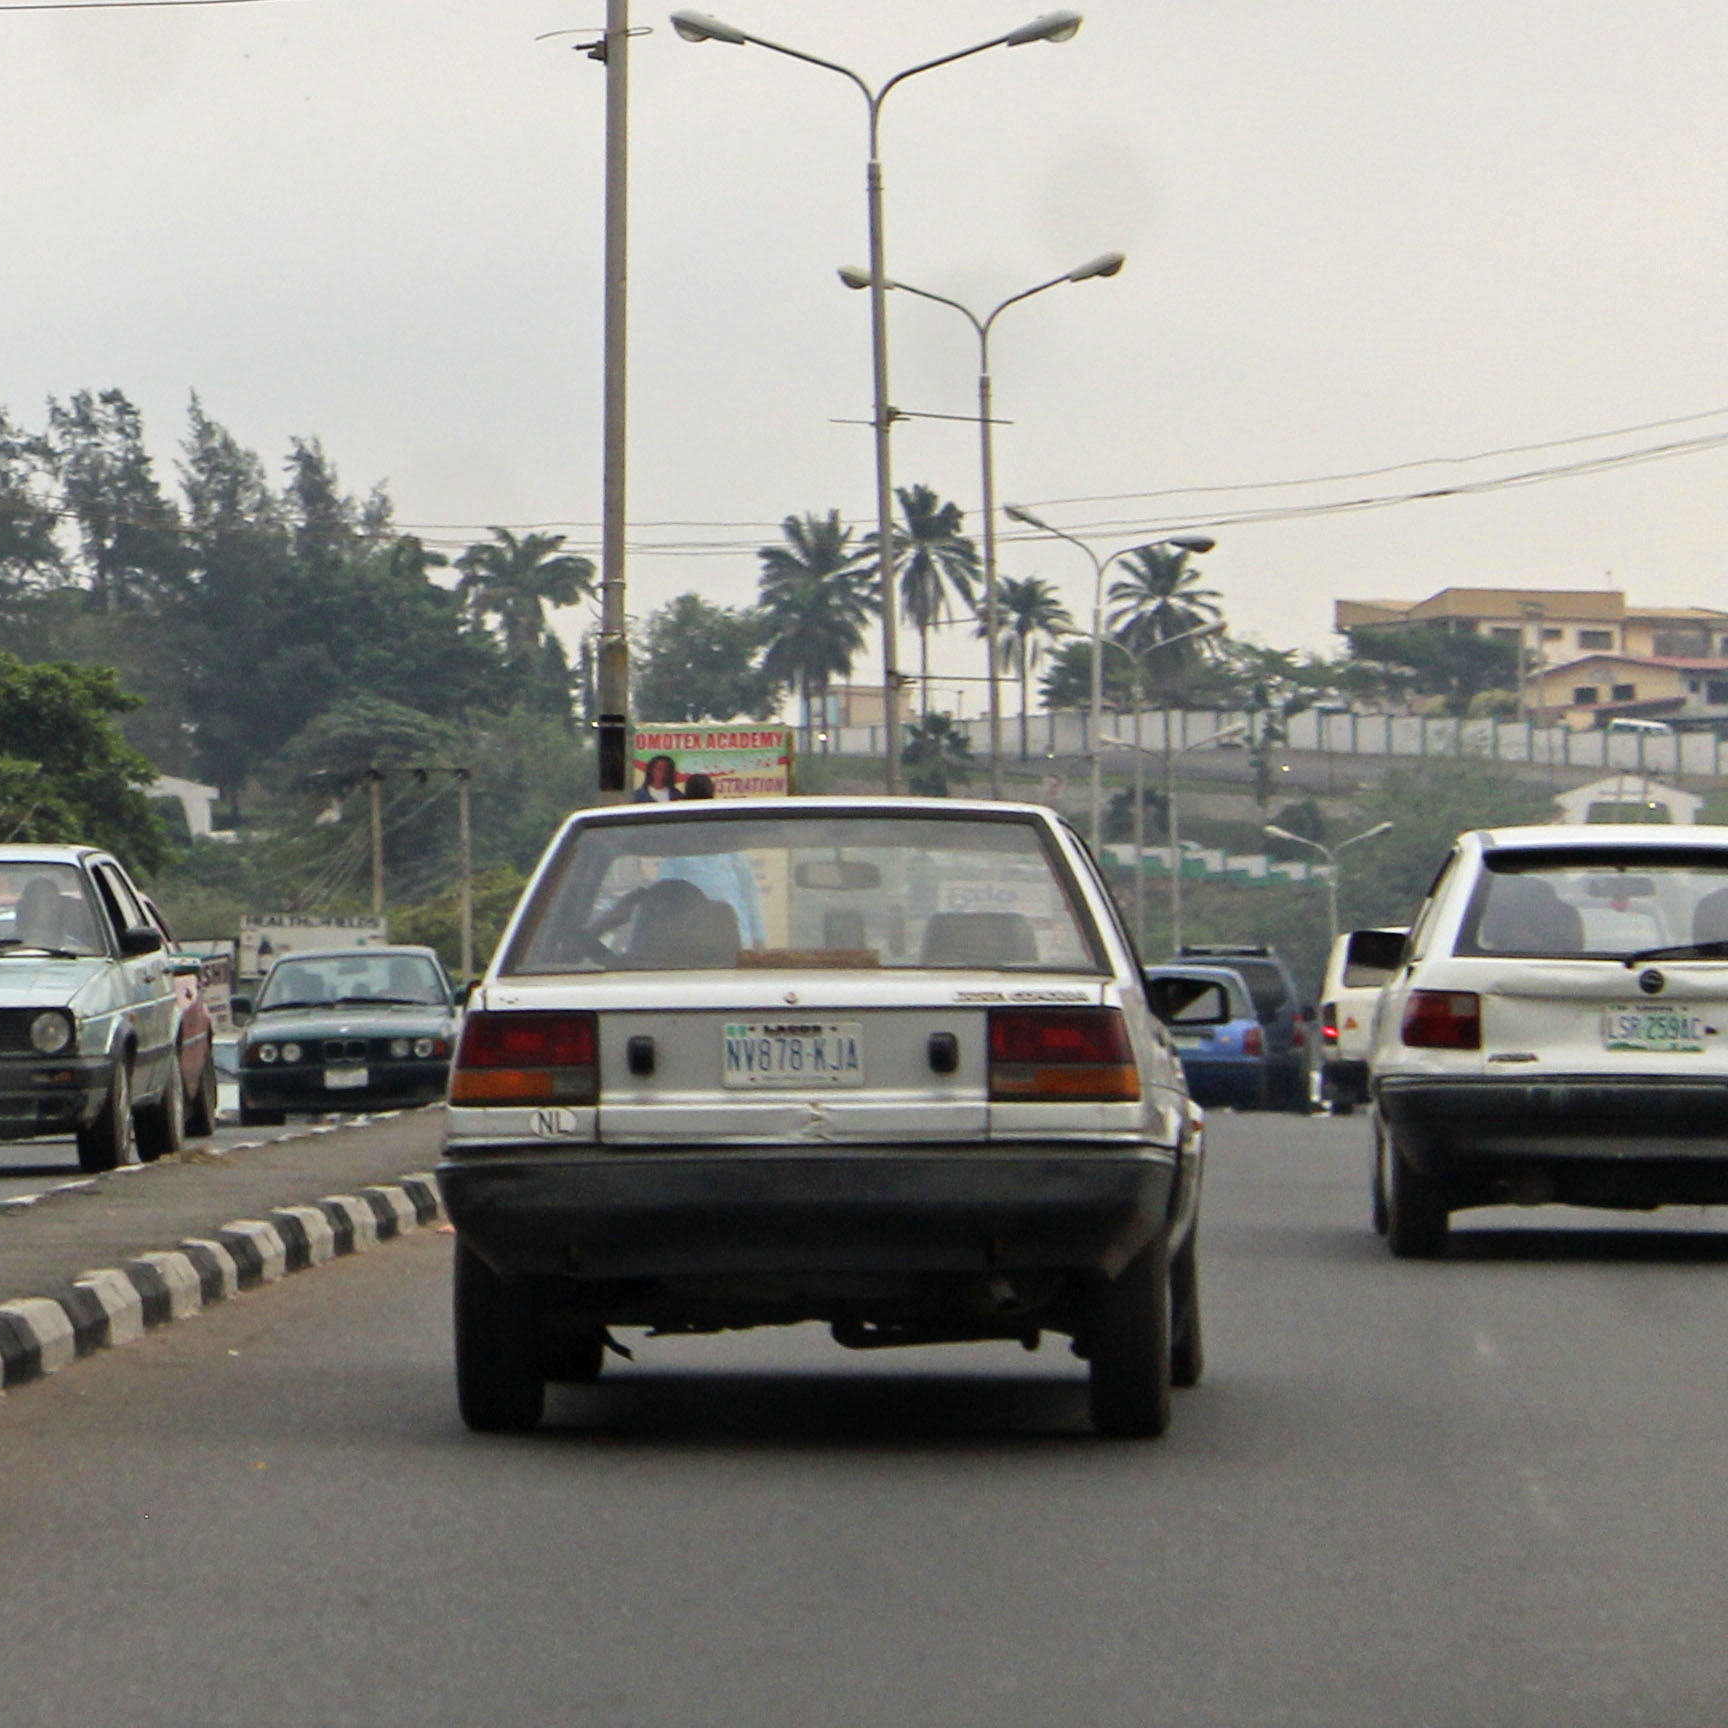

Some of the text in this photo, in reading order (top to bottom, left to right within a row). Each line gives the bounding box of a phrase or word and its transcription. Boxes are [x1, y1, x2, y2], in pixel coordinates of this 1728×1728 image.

[706, 732, 784, 749] ACADEMY
[726, 1038, 859, 1071] NV878-KJA
[539, 1111, 569, 1135] NL
